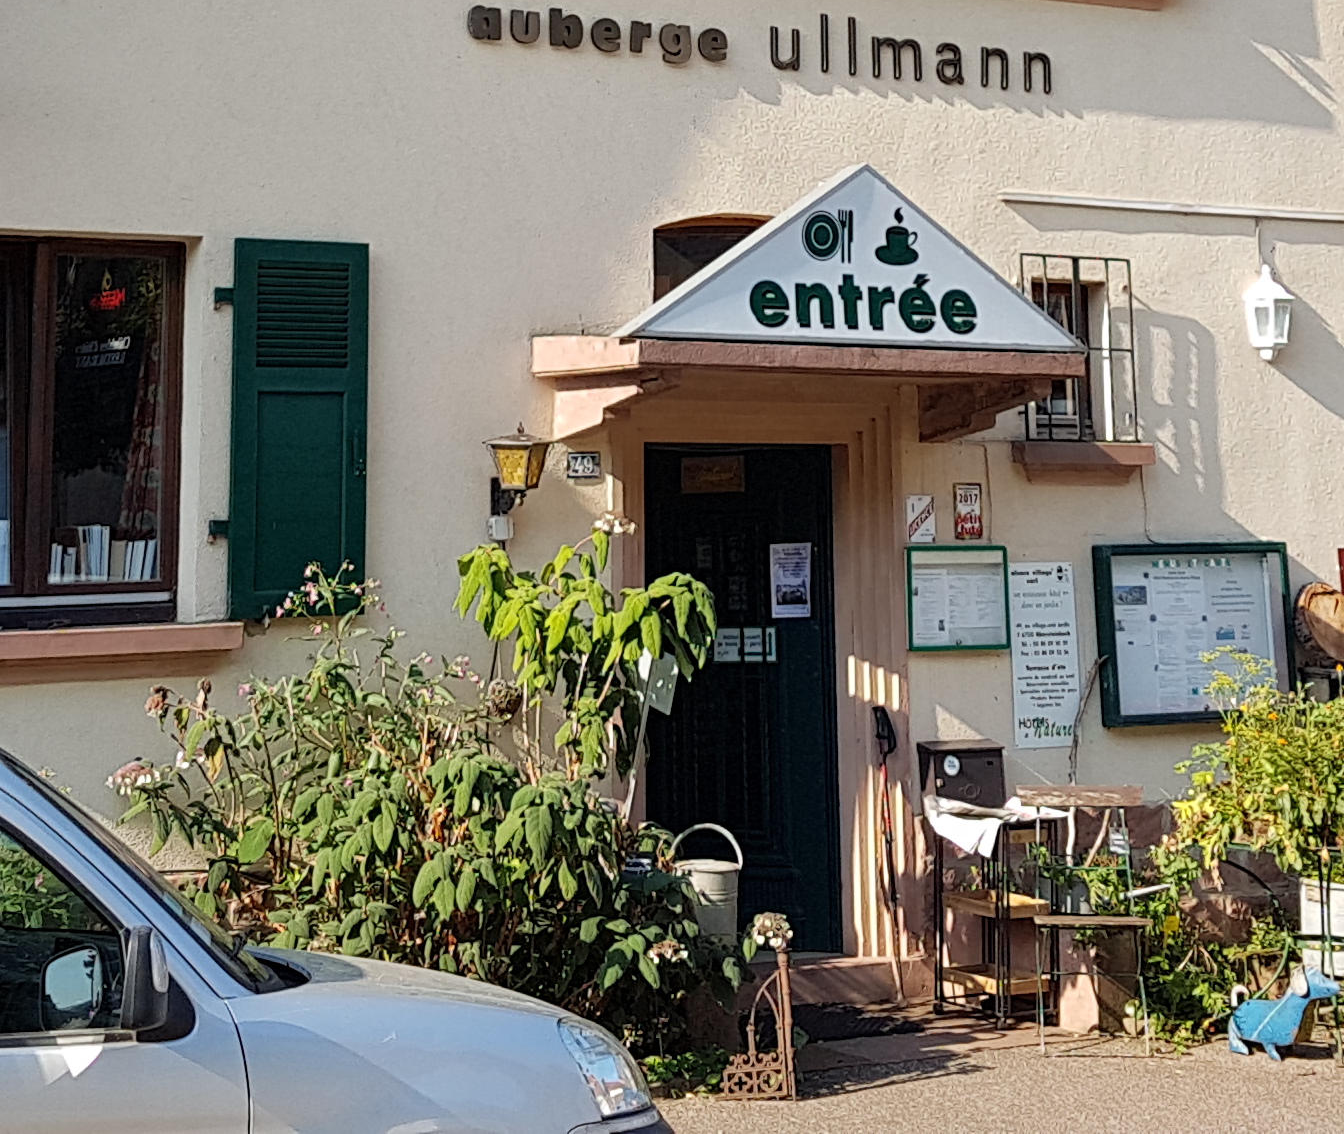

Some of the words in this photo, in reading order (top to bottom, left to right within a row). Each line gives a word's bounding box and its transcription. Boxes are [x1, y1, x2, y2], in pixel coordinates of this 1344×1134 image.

[468, 4, 729, 64] auberge
[770, 13, 1052, 95] ullmann
[749, 273, 978, 335] entrée
[573, 456, 595, 474] 49
[959, 493, 978, 504] 2017
